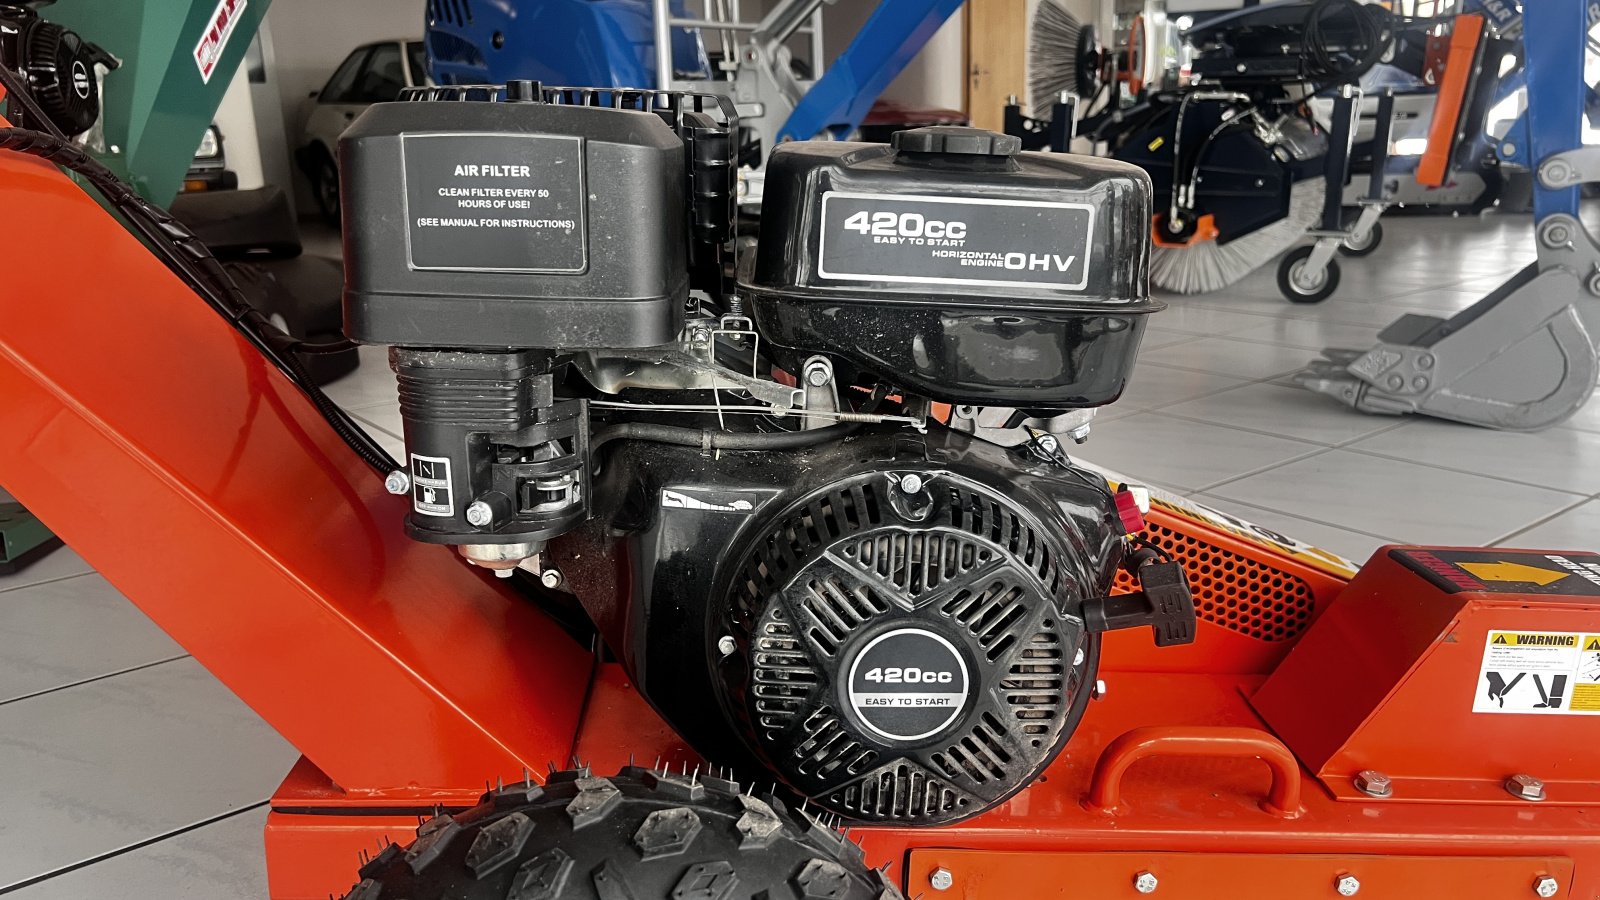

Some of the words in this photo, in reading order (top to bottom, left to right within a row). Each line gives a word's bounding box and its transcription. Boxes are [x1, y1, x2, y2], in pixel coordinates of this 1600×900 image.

[454, 165, 479, 177] AIR
[481, 165, 531, 178] FILTER
[438, 187, 470, 197] CLEAN
[471, 188, 504, 198] FILTER
[504, 189, 536, 198] EVERY
[537, 189, 549, 198] 50
[458, 200, 492, 209] HOURS
[493, 200, 506, 209] OF
[508, 200, 531, 209] USE!
[417, 217, 439, 228] (SEE
[440, 218, 479, 228] MANUAL
[480, 218, 500, 228] FOR
[501, 219, 575, 230] INSTRUCTIONS)
[843, 210, 967, 239] 420cc
[873, 236, 905, 245] EASY
[908, 237, 924, 246] TO
[927, 237, 966, 248] START
[932, 249, 1004, 261] HORIZONTAL
[960, 258, 1003, 268] ENGINE
[1004, 252, 1076, 272] OHV
[1516, 634, 1575, 646] WARNING
[864, 667, 953, 684] 420cc
[865, 698, 894, 706] EASY
[897, 698, 912, 706] TO
[915, 698, 950, 706] START
